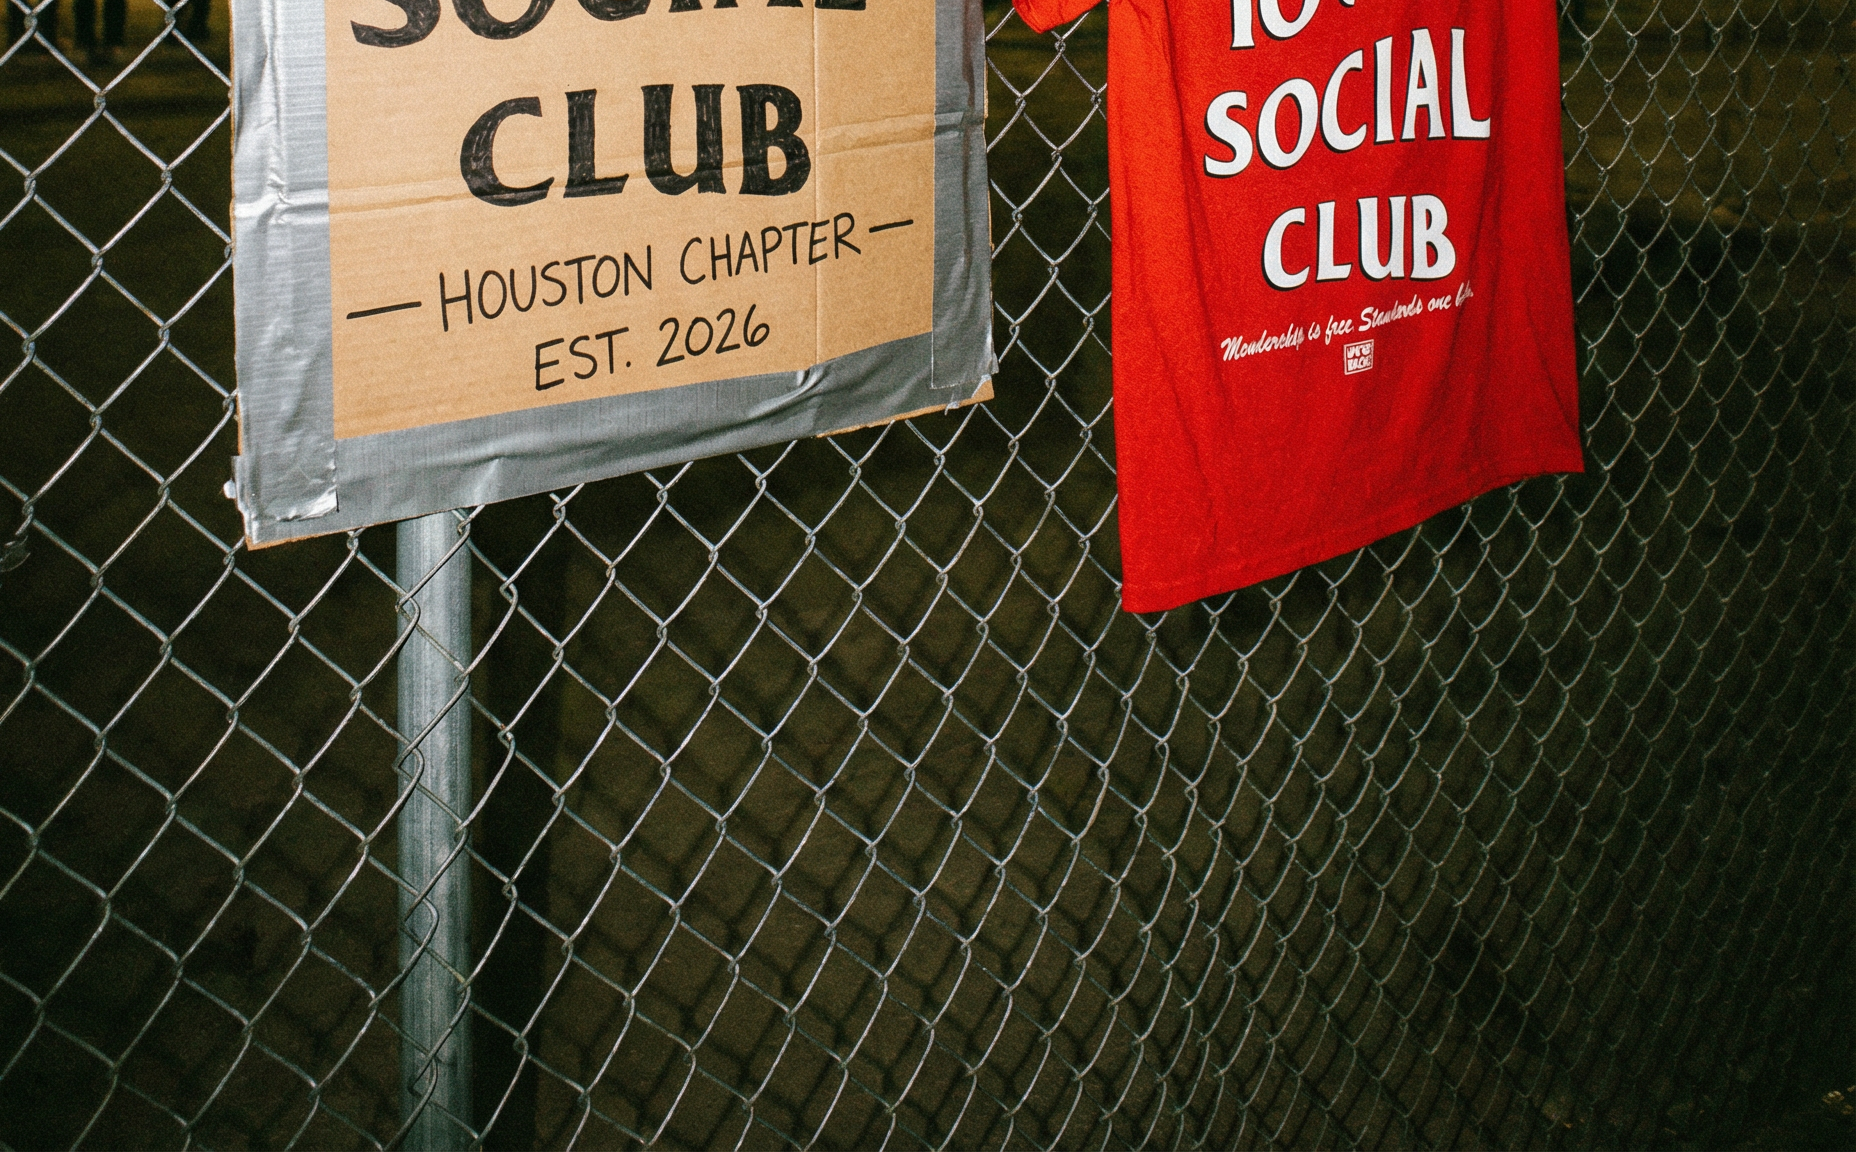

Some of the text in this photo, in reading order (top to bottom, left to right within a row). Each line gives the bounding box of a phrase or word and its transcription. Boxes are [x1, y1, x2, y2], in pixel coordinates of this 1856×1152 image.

[459, 83, 812, 208] CLUB
[1203, 27, 1492, 179] SOCIAL
[439, 211, 862, 333] HOUSTON CHAPTER
[1261, 193, 1457, 292] CLUB
[534, 303, 771, 392] EST. 2026
